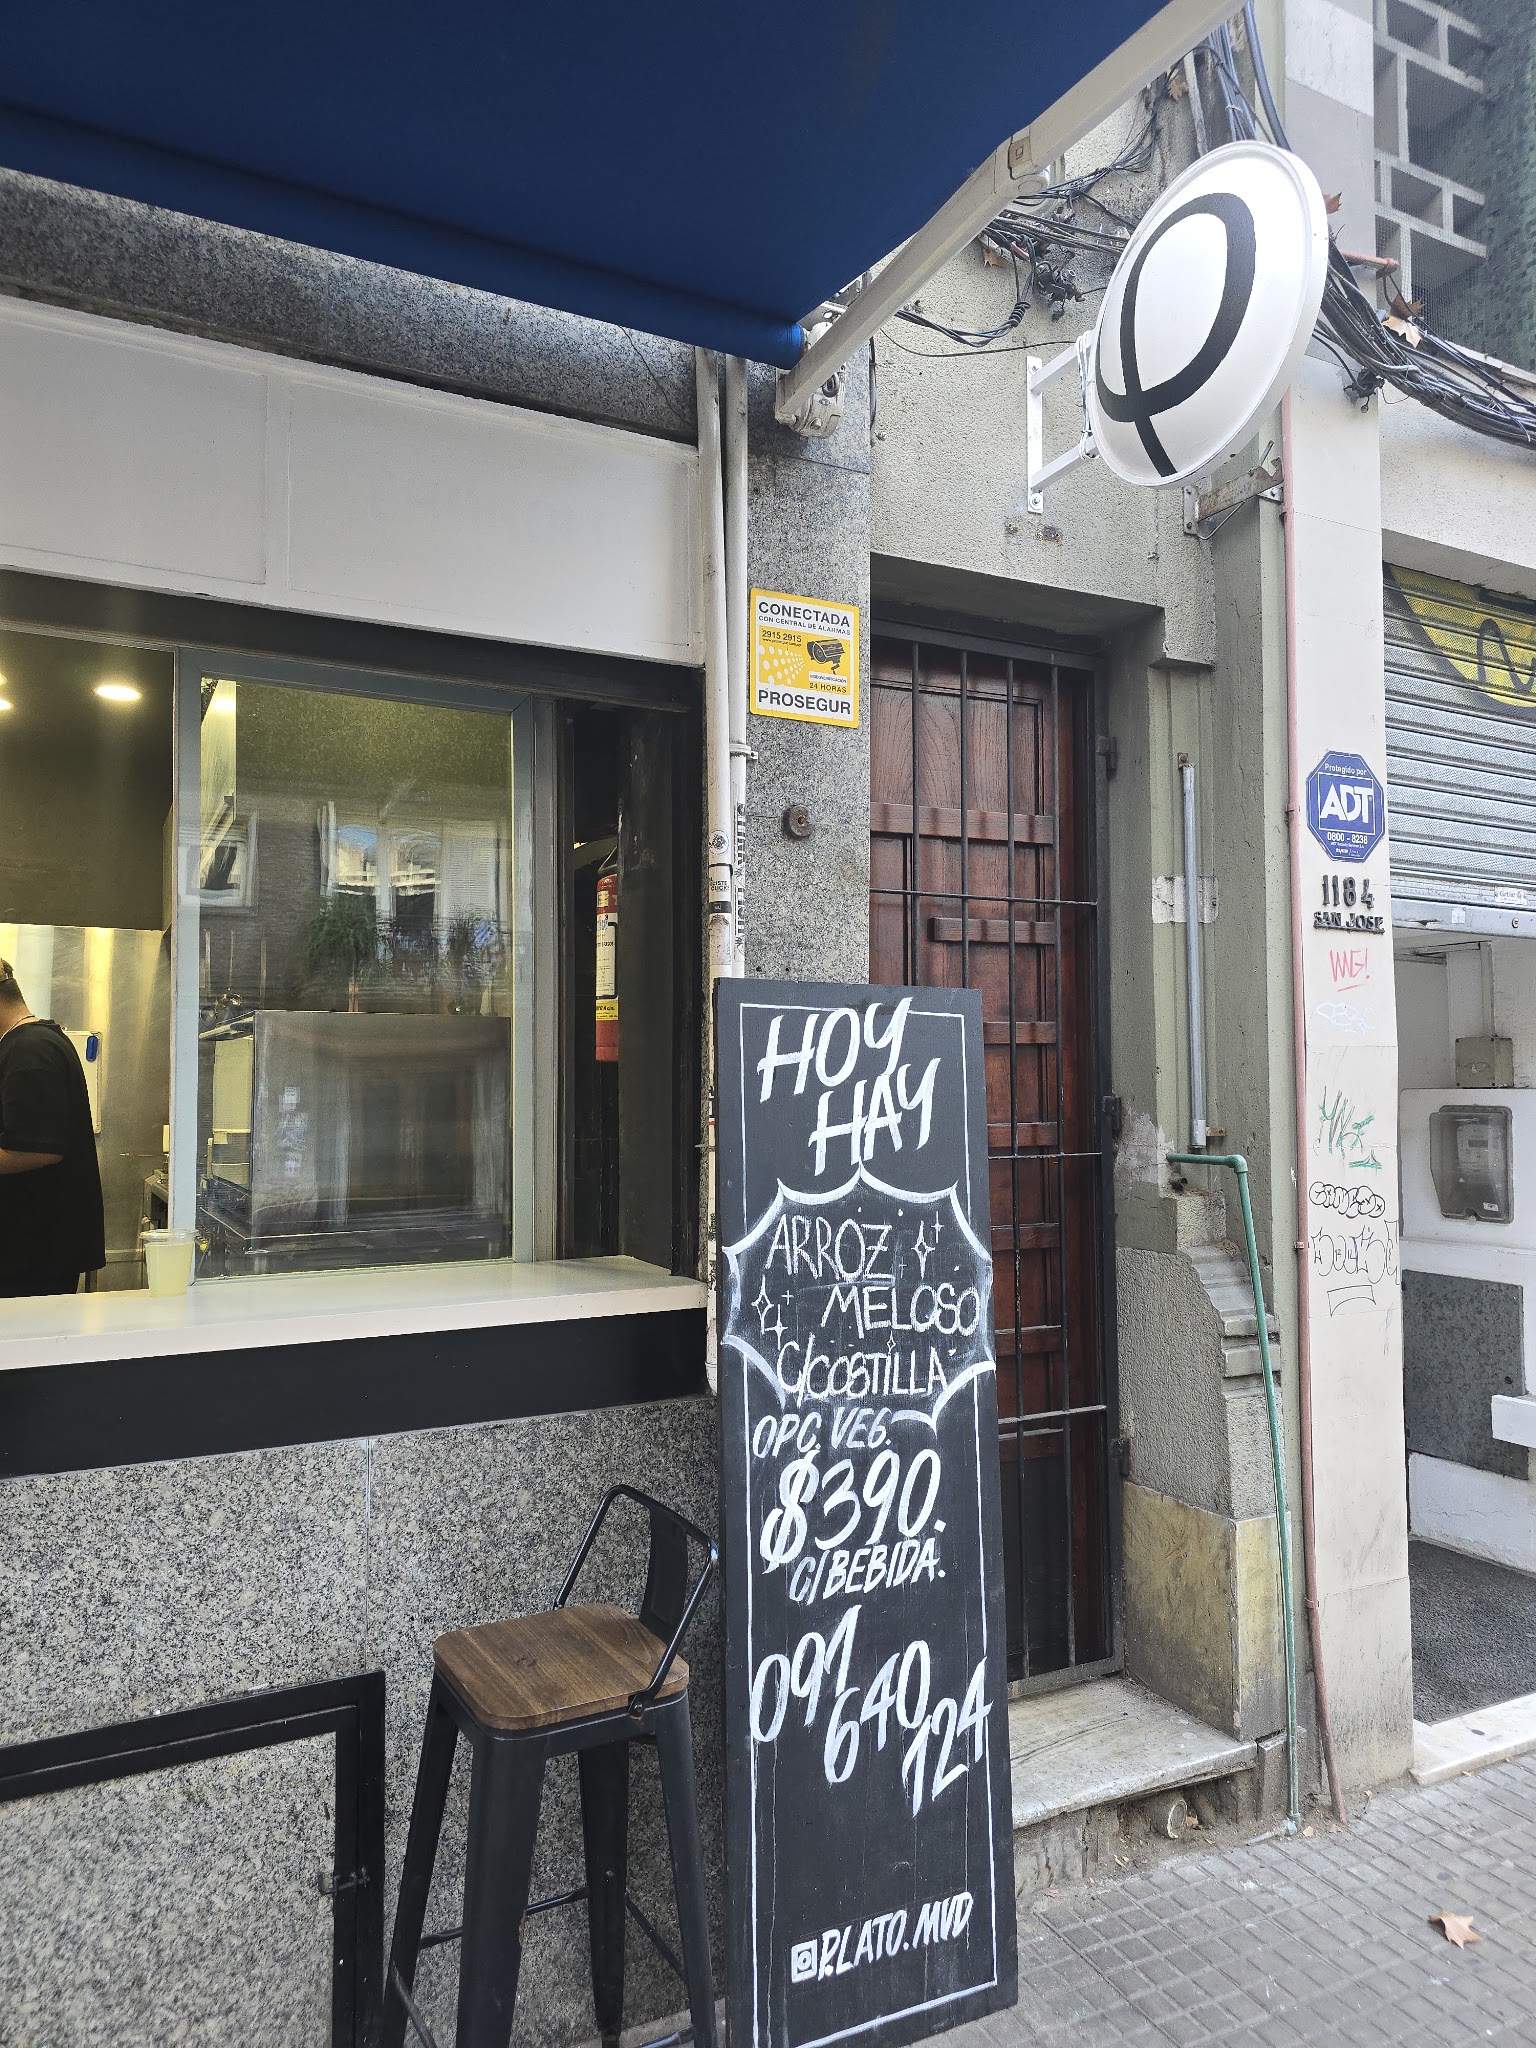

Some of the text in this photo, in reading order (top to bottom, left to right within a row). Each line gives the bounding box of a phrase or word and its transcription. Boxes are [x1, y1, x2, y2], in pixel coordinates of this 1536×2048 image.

[758, 601, 850, 628] CONECTADA
[758, 615, 774, 624] CON
[775, 617, 807, 628] CENTRAL
[818, 624, 851, 636] ALARMAS
[762, 629, 802, 643] 2915 2915
[759, 690, 850, 714] PROSEGUR
[820, 683, 847, 694] HORAS
[1324, 763, 1356, 776] Protegido
[1320, 782, 1374, 824] ADT
[1327, 831, 1345, 842] 0800
[1351, 834, 1368, 845] 8238
[1322, 874, 1375, 911] 1184
[1313, 911, 1383, 931] SAN JOSE
[757, 996, 914, 1103] HOY
[808, 1057, 941, 1177] HAY
[765, 1213, 896, 1283] ARROZ
[820, 1282, 981, 1340] MELOSO
[776, 1330, 951, 1409] C/COSTILLA
[752, 1406, 893, 1459] OPC. VEG.
[759, 1448, 947, 1575] $390.
[789, 1537, 946, 1606] C/BEBIDA.
[750, 1604, 862, 1743] 091
[823, 1639, 931, 1784] 640
[901, 1655, 995, 1818] 124
